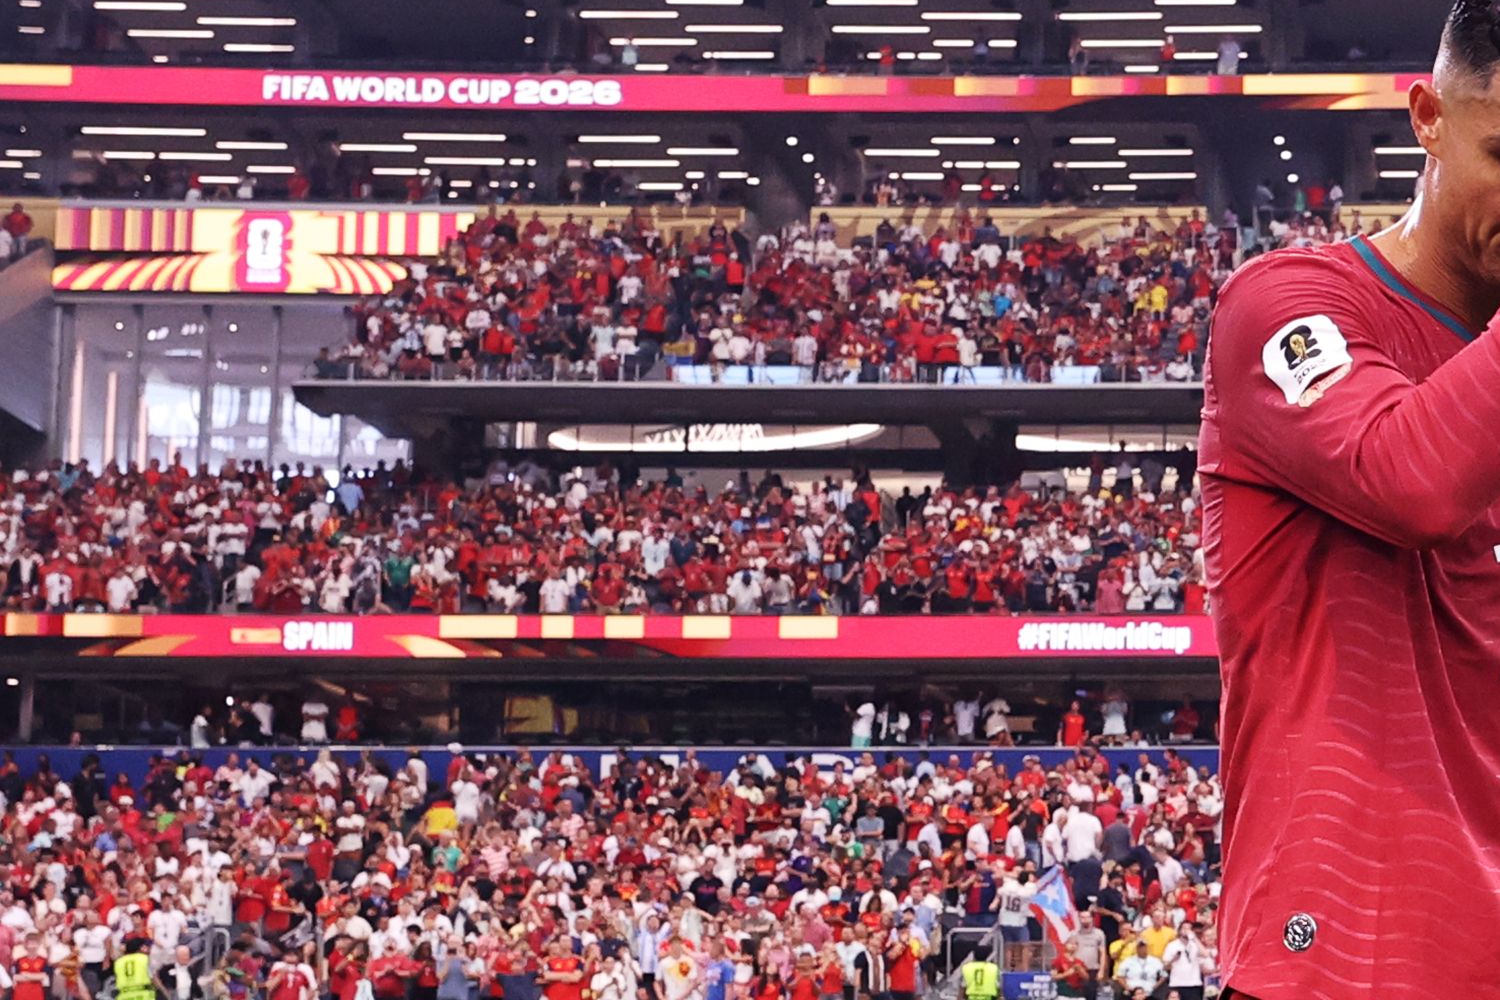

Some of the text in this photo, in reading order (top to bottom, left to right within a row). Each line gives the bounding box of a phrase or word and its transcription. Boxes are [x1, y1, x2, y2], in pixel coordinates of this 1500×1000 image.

[262, 74, 622, 106] FIFA WORLD CUP 2026
[283, 621, 354, 651] SPAIN
[1017, 621, 1192, 655] #FIFAWorldCup
